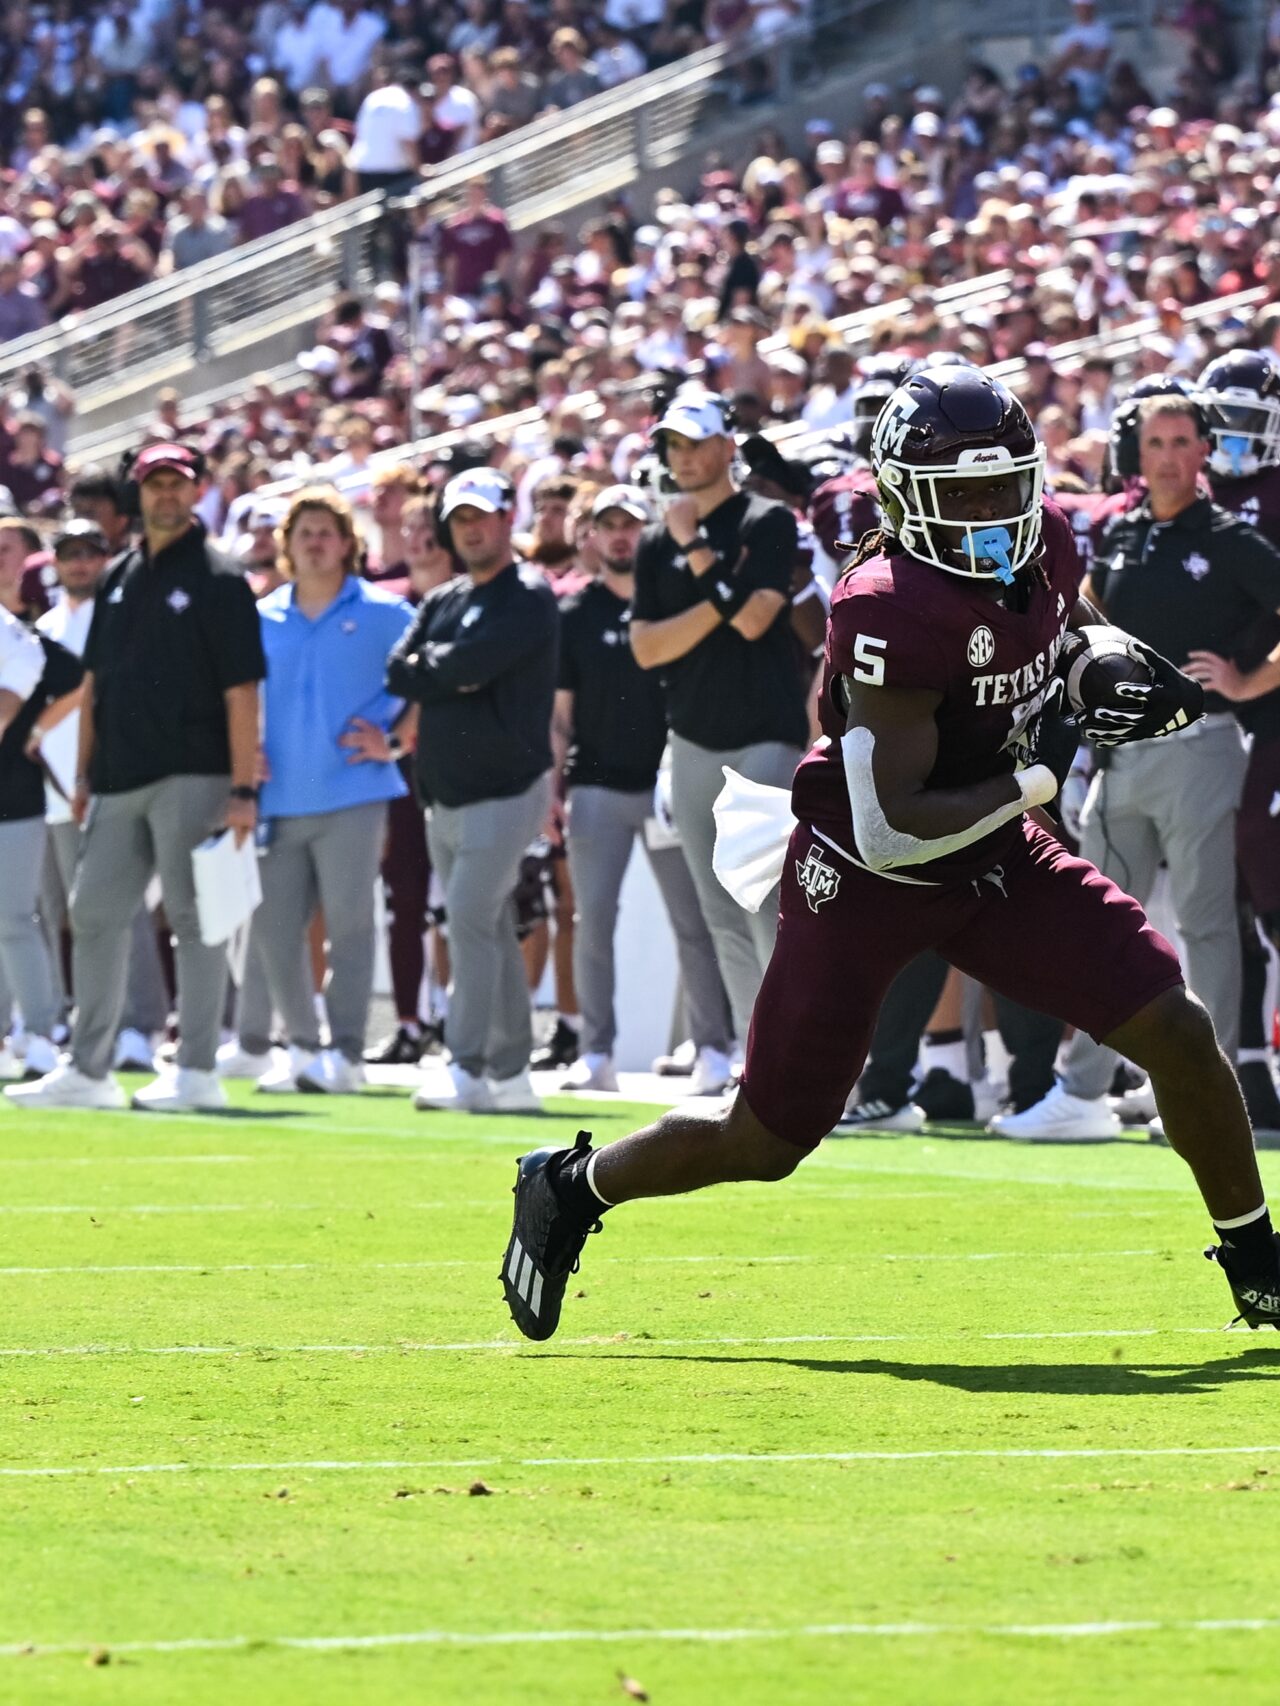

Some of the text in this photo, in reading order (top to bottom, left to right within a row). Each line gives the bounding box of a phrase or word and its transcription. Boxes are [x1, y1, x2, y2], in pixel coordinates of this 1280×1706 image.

[853, 632, 888, 687] 5
[970, 628, 994, 665] SEC
[971, 651, 1046, 707] TEXAS
